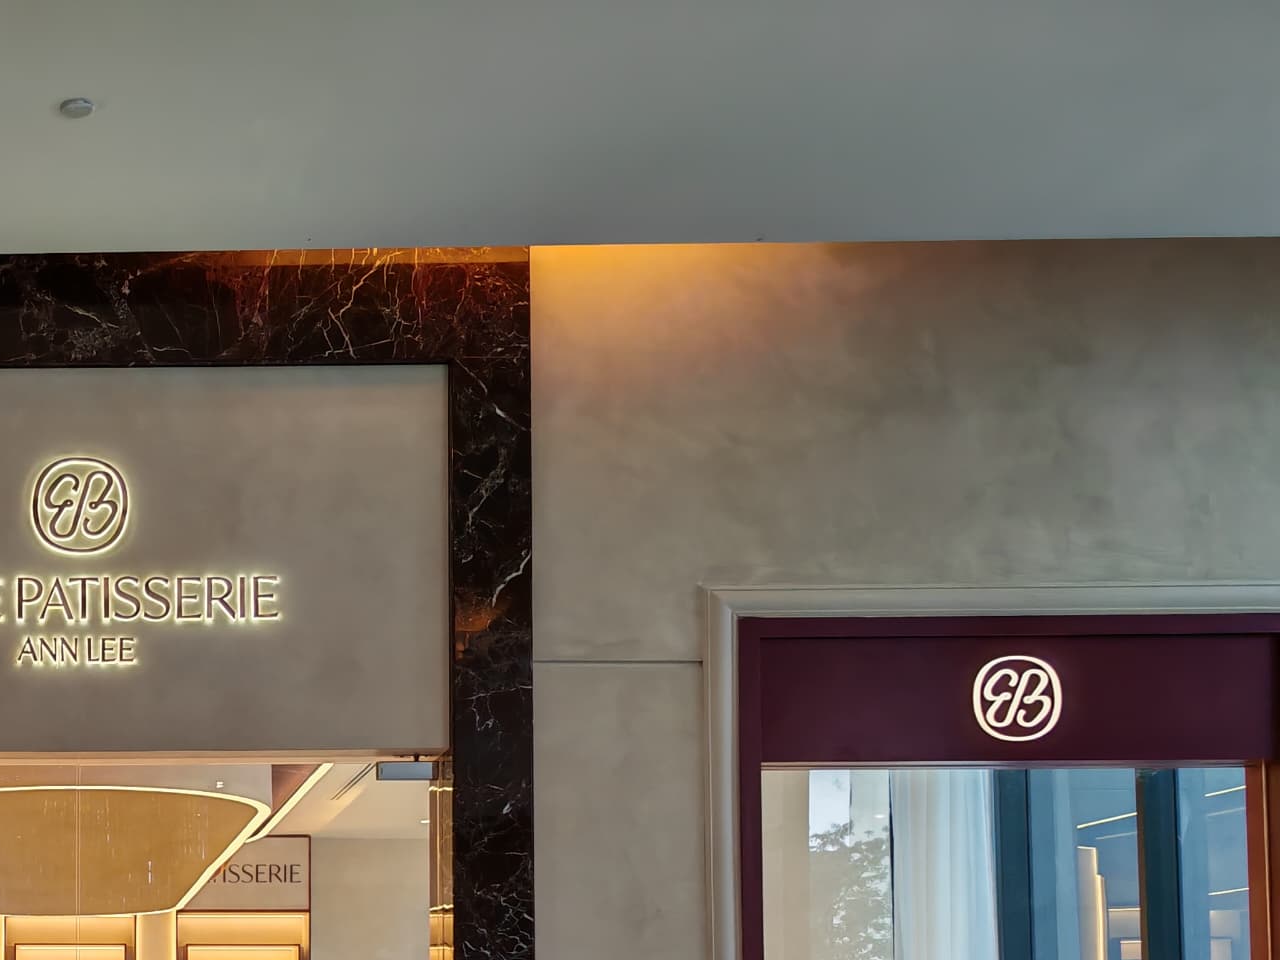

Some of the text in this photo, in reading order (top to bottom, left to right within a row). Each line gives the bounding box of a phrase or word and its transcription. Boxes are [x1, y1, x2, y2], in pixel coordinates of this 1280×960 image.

[15, 574, 280, 621] PATISSERIE
[16, 635, 137, 663] ANN LEE
[209, 863, 303, 884] ISSERIE
